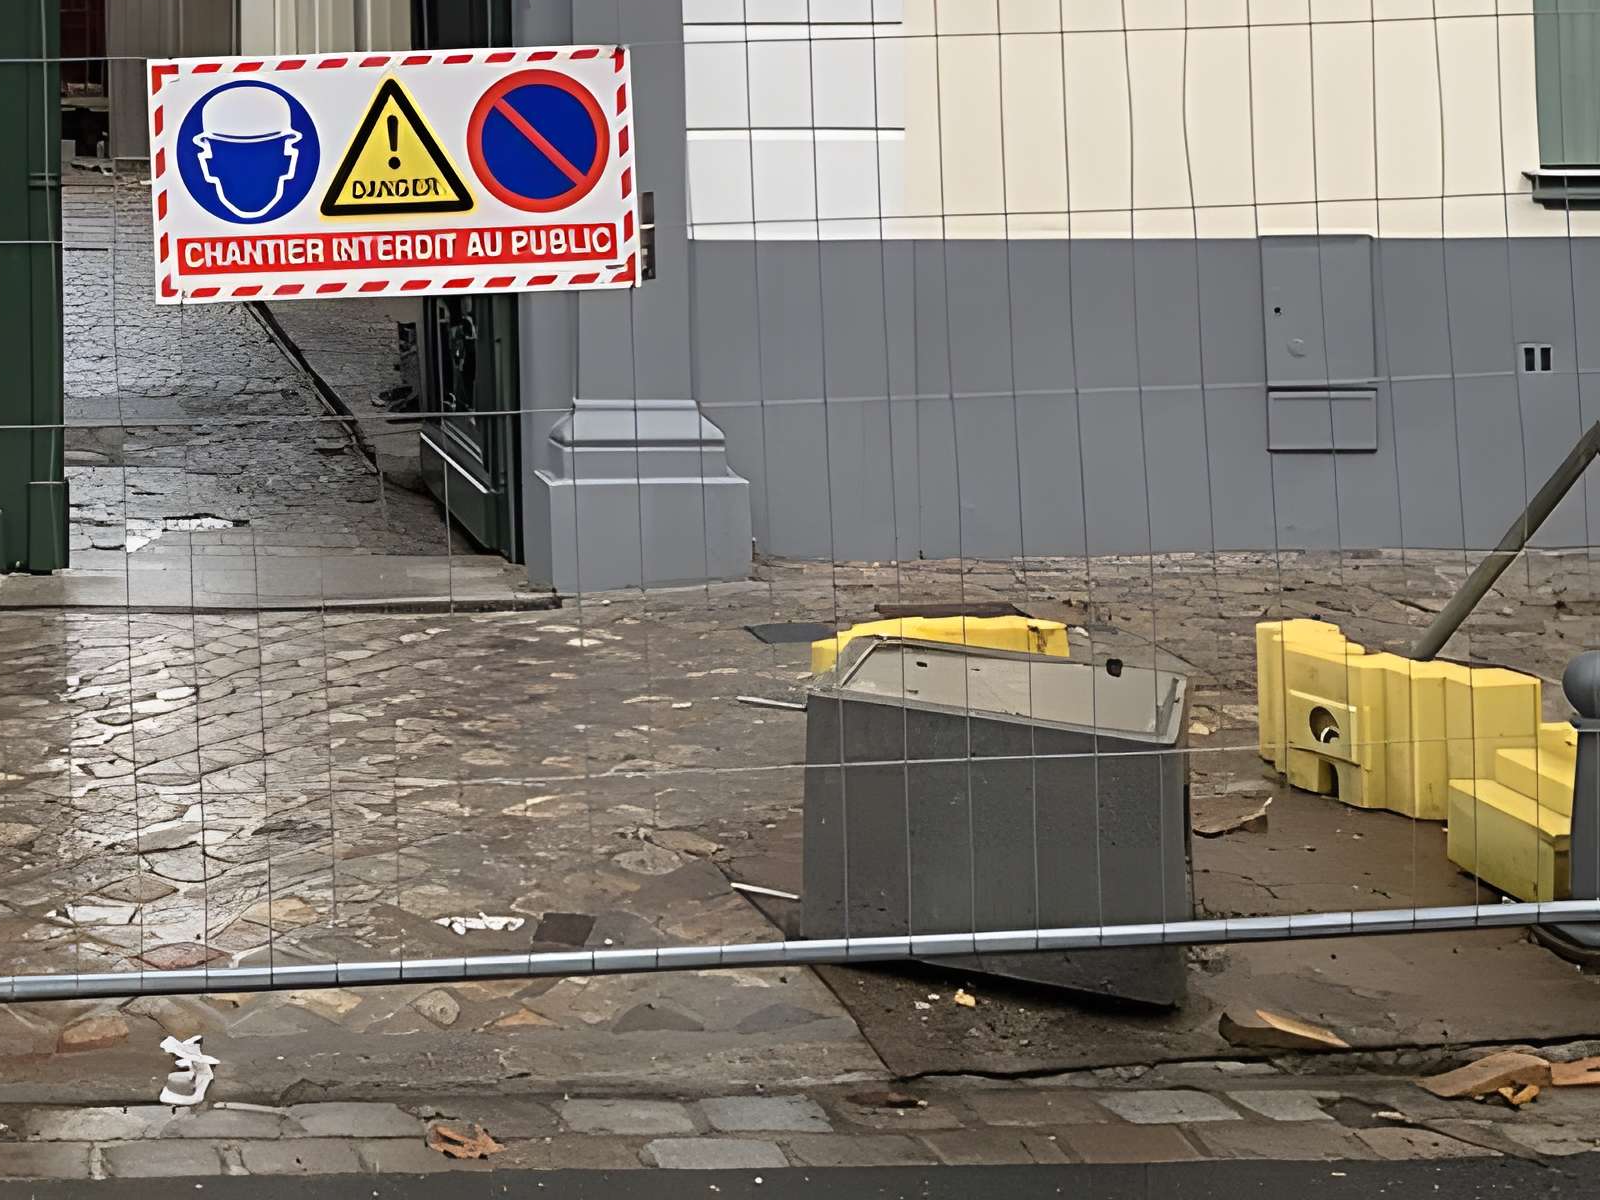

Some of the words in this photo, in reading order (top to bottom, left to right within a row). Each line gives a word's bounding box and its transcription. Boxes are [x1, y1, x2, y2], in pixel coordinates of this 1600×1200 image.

[185, 238, 325, 268] CHANTIER
[332, 232, 457, 262] INTERDIT
[466, 230, 503, 258] AU
